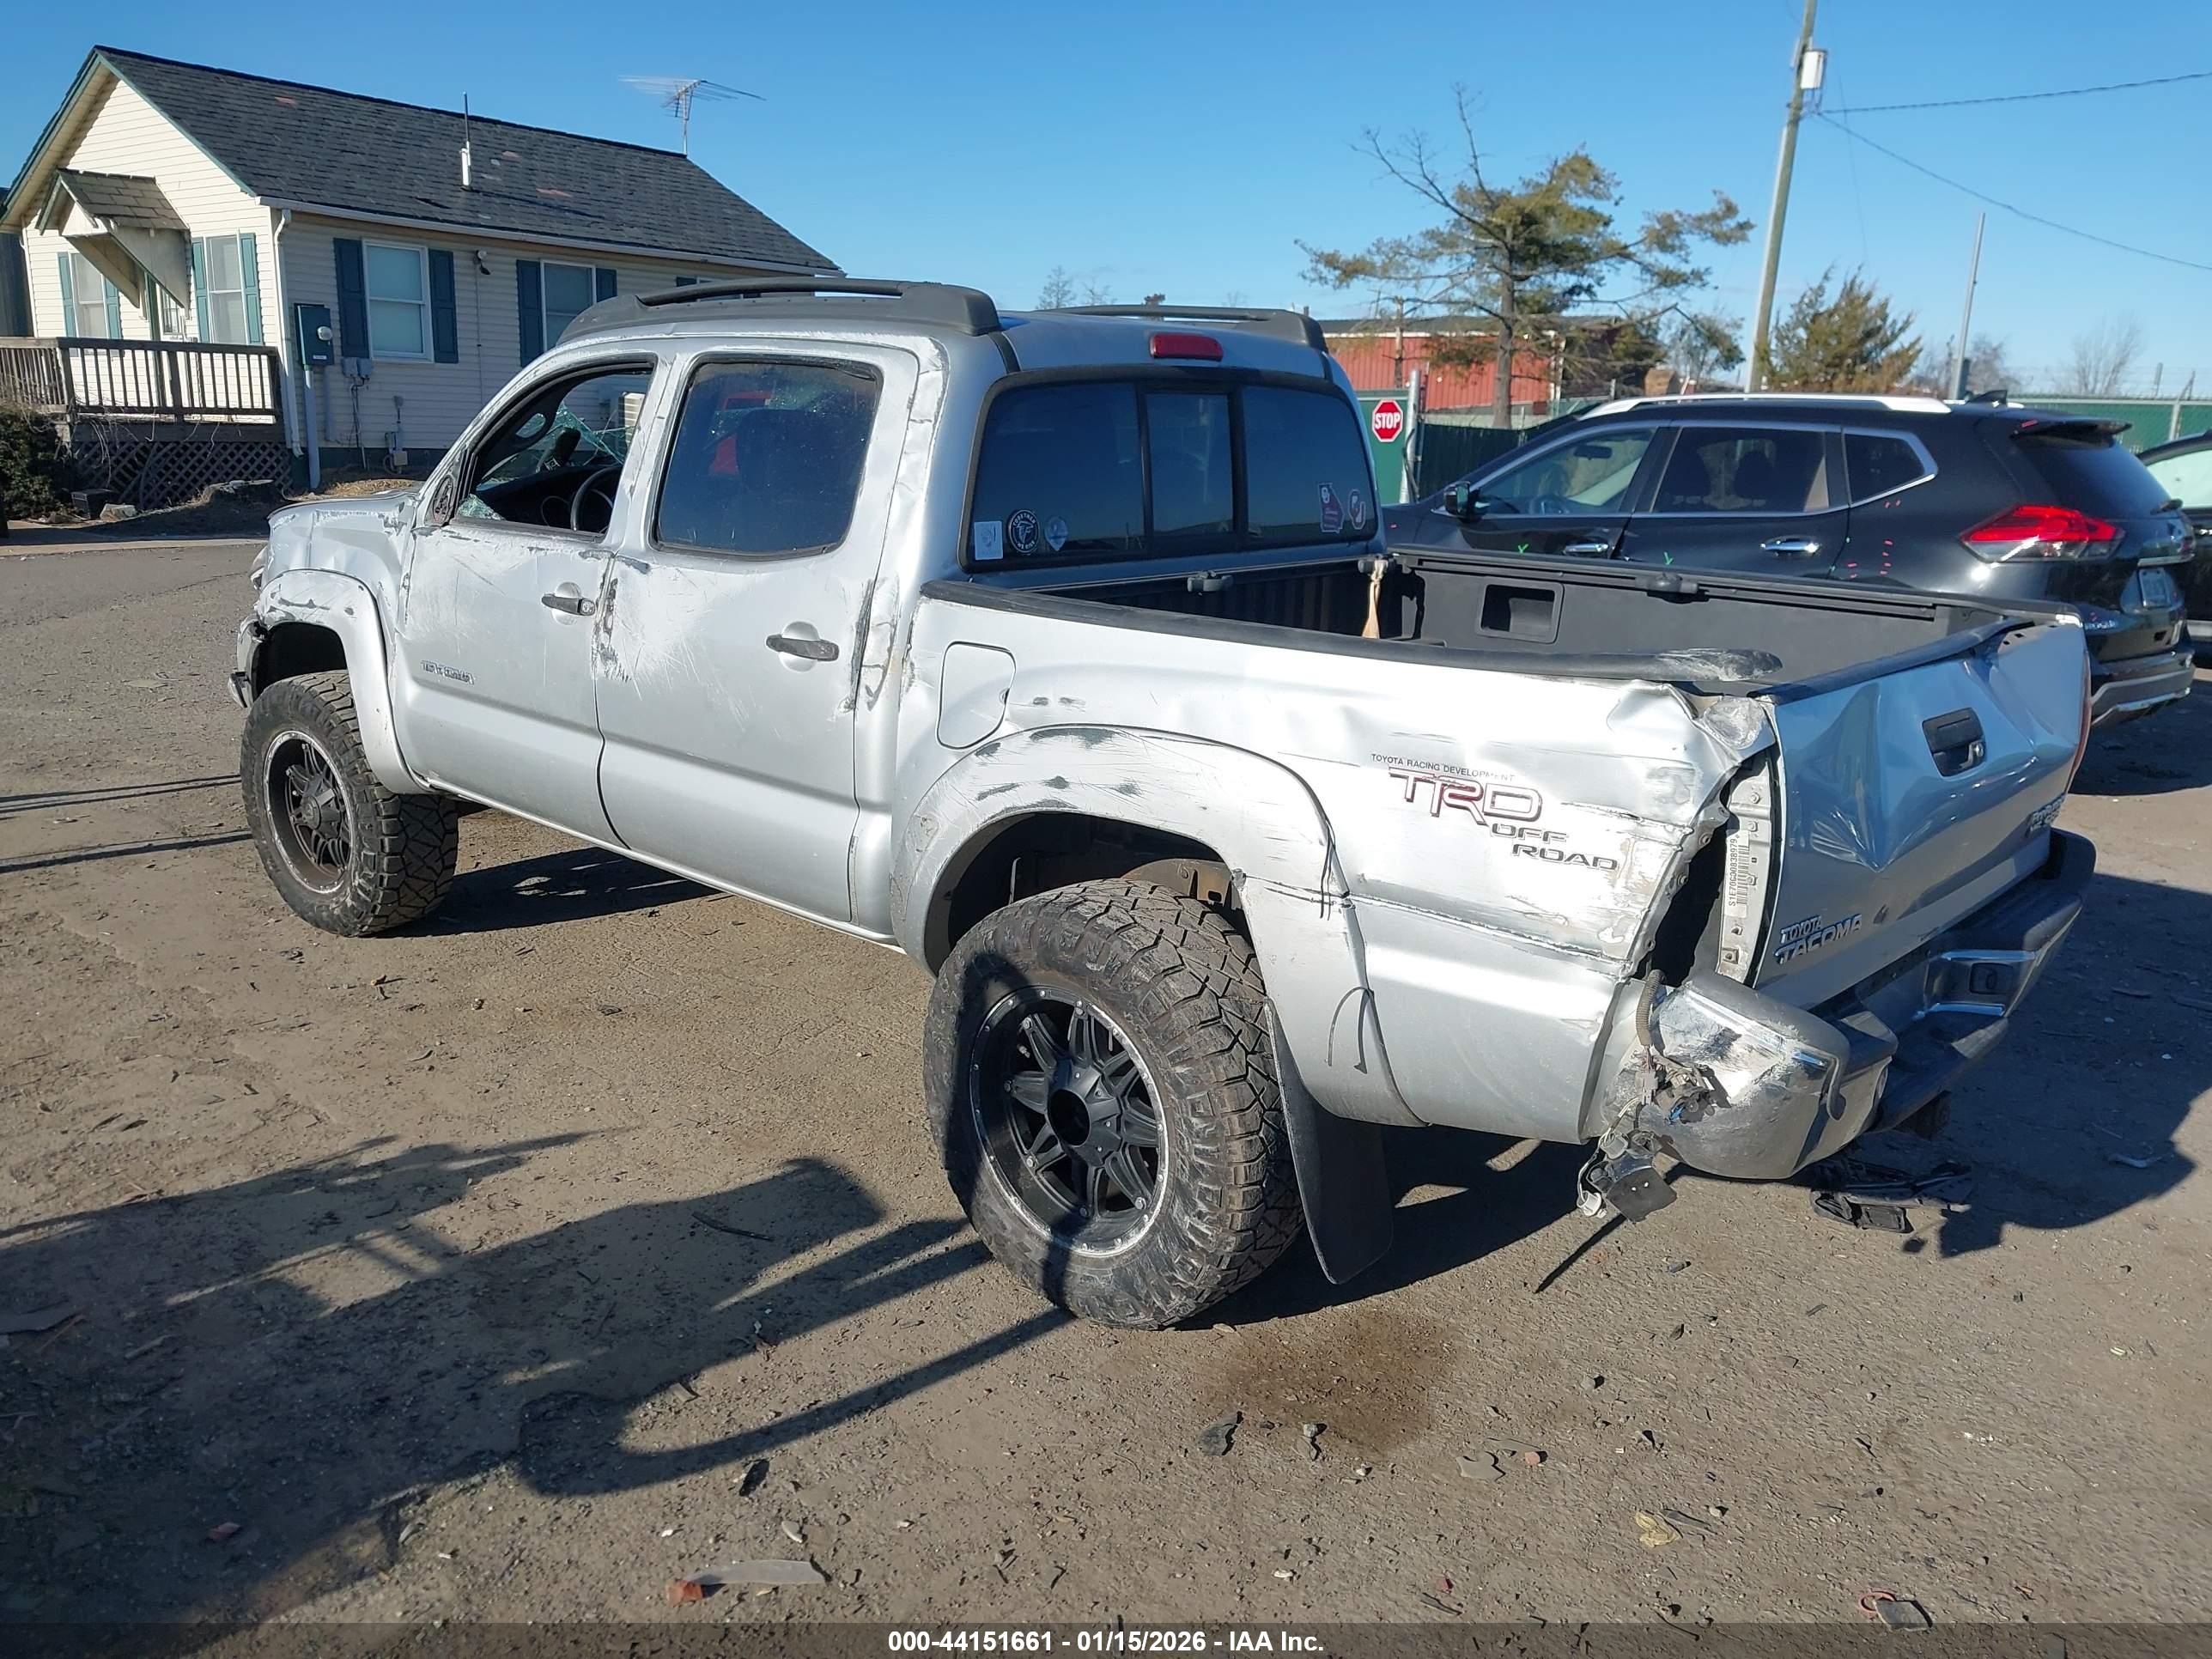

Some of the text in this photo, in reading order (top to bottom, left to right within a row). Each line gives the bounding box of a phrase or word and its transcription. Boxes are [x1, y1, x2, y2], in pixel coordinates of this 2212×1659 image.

[1375, 412, 1401, 429] STOP
[1370, 753, 1404, 765] TOYOTA
[1407, 759, 1440, 772] RACING
[1389, 767, 1543, 826] TRD
[1491, 823, 1568, 843] OFF
[1512, 843, 1619, 872] ROAD
[1774, 913, 1863, 964] TACOMA
[1780, 915, 1821, 944] TOYOTA
